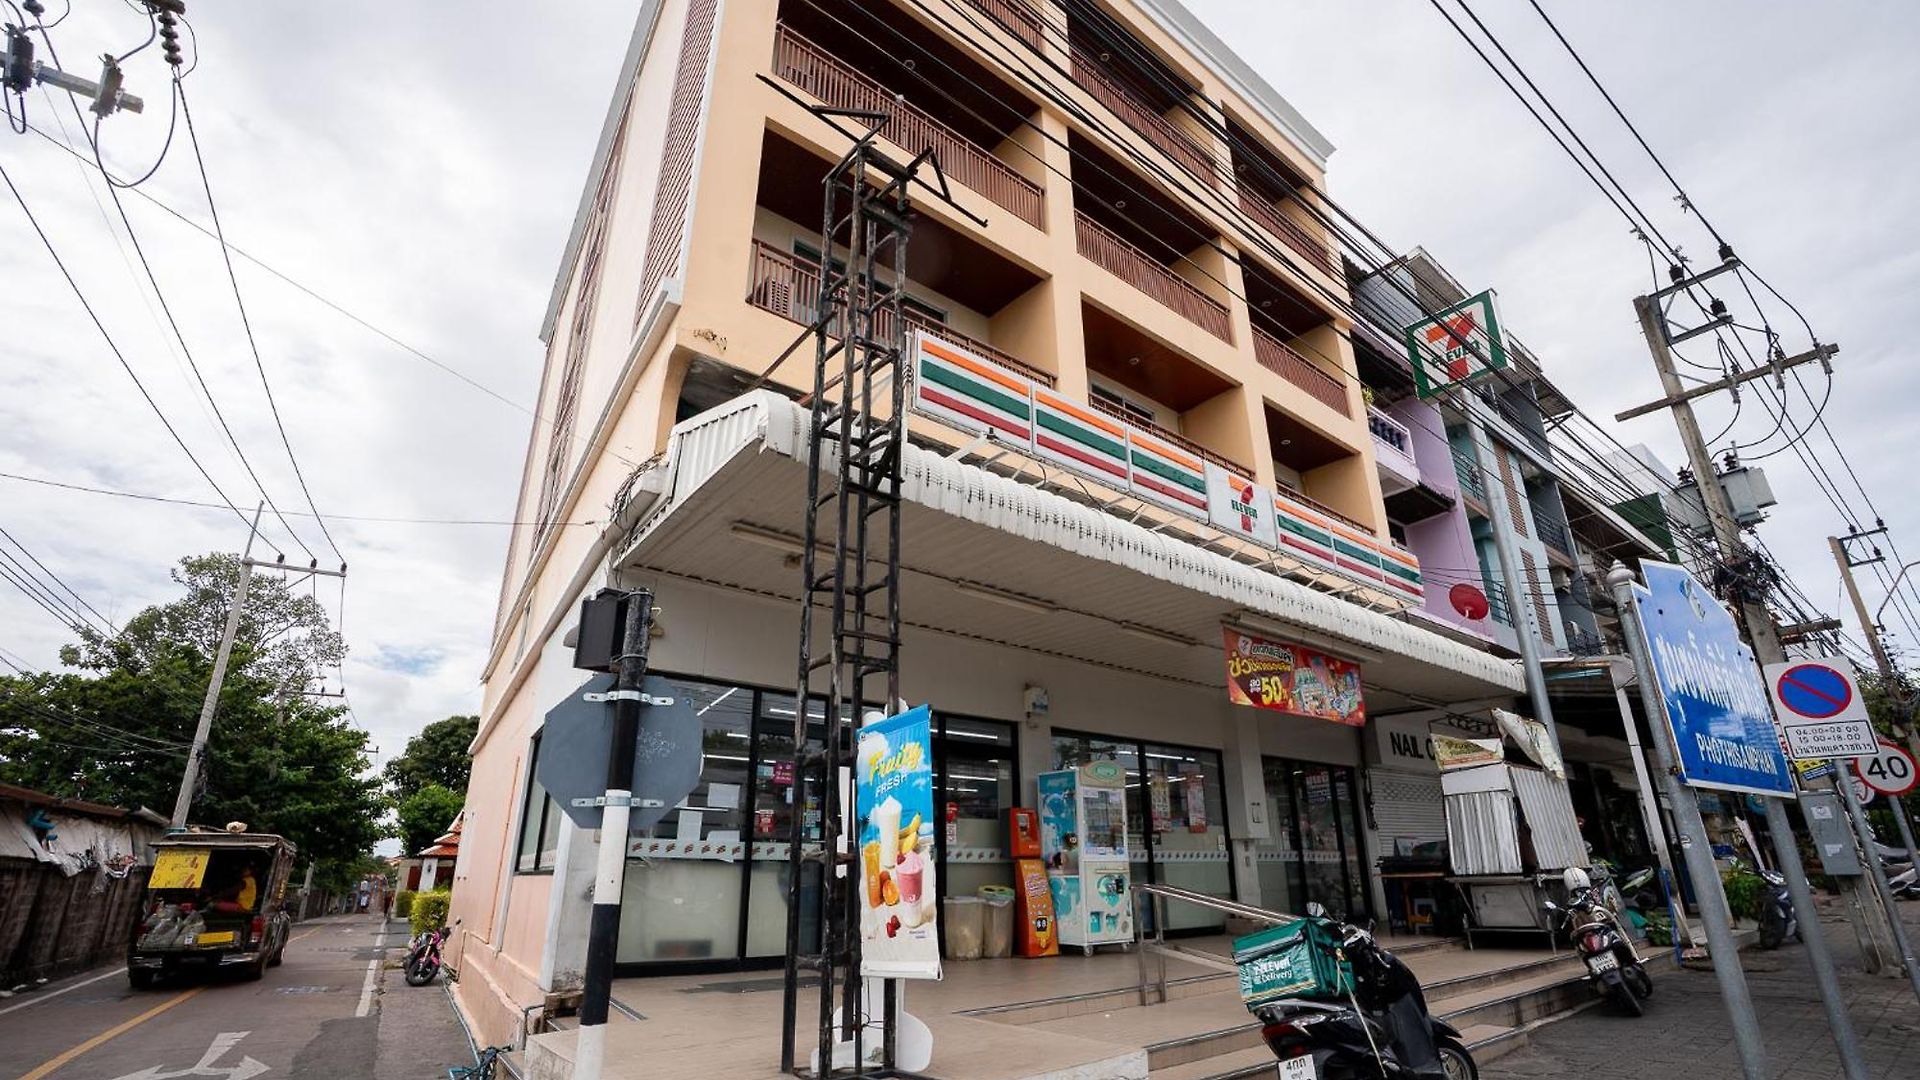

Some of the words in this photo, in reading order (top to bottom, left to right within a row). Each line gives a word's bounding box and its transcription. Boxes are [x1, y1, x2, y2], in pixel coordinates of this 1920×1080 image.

[1228, 474, 1254, 533] 7
[1261, 675, 1283, 705] 50
[1389, 731, 1424, 759] NAIL
[1695, 732, 1779, 776] PHOTHISAMPHAN
[1867, 755, 1909, 780] 40
[874, 772, 908, 798] FRESH
